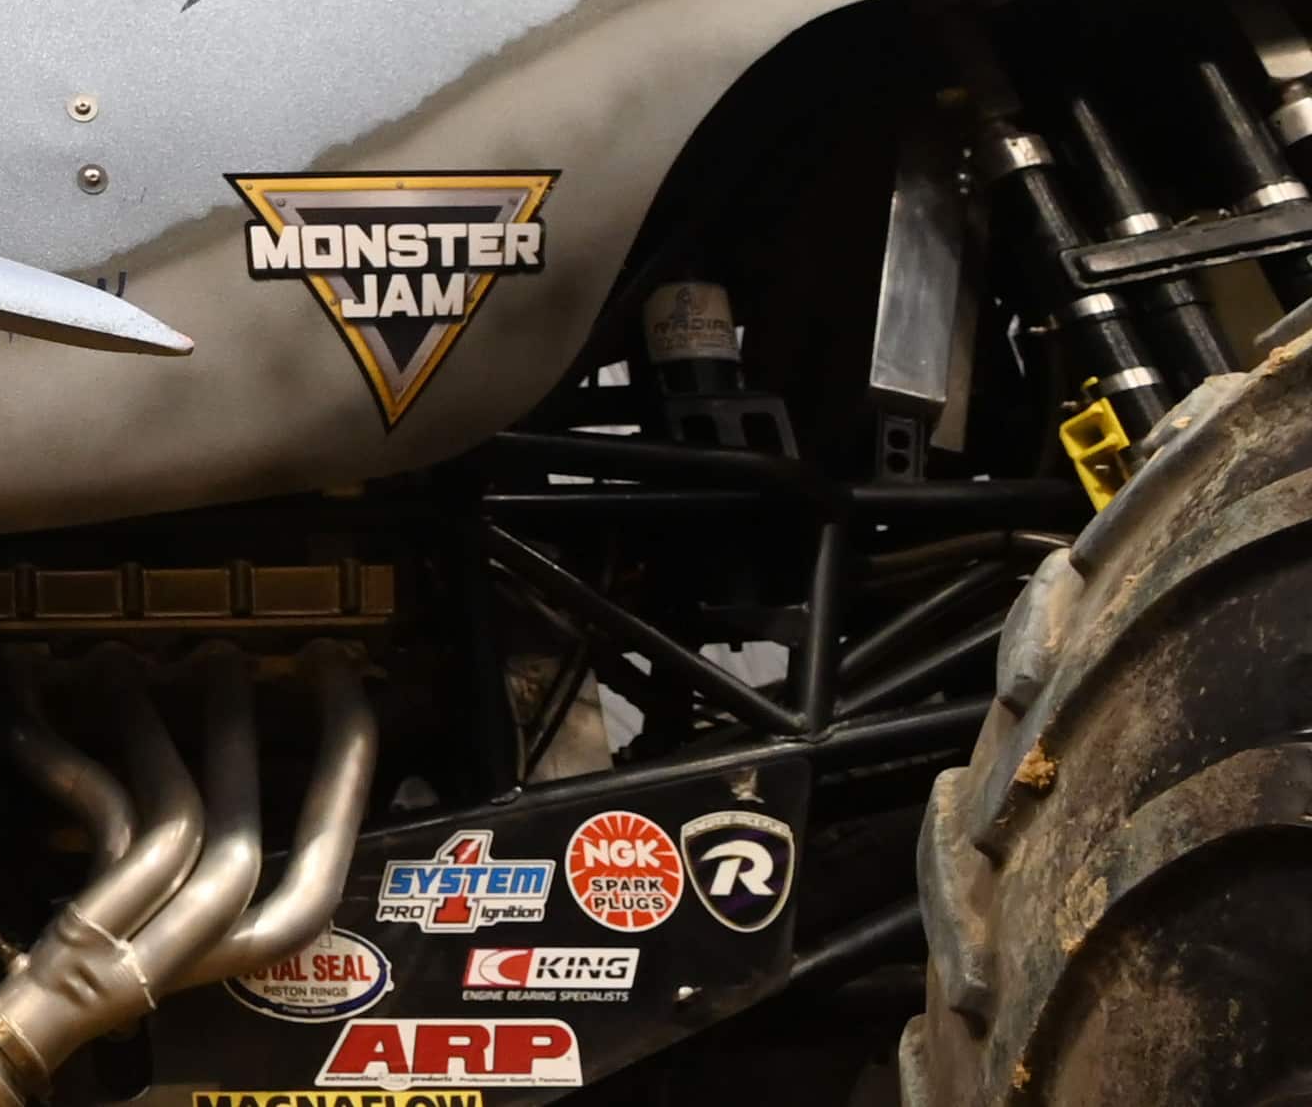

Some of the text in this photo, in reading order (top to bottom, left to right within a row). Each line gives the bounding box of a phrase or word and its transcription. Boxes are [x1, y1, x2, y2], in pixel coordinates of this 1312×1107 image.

[249, 222, 542, 270] MONSTER
[341, 273, 467, 319] JAM
[582, 838, 662, 869] NGK
[388, 867, 547, 894] SYSTEM
[590, 878, 663, 893] SPARK
[378, 903, 542, 923] PRO Ignition
[593, 895, 665, 911] PLUGS
[312, 955, 372, 982] SEAL
[536, 956, 630, 979] KING
[263, 986, 348, 998] PISTON RINGS
[327, 1024, 572, 1074] ARP
